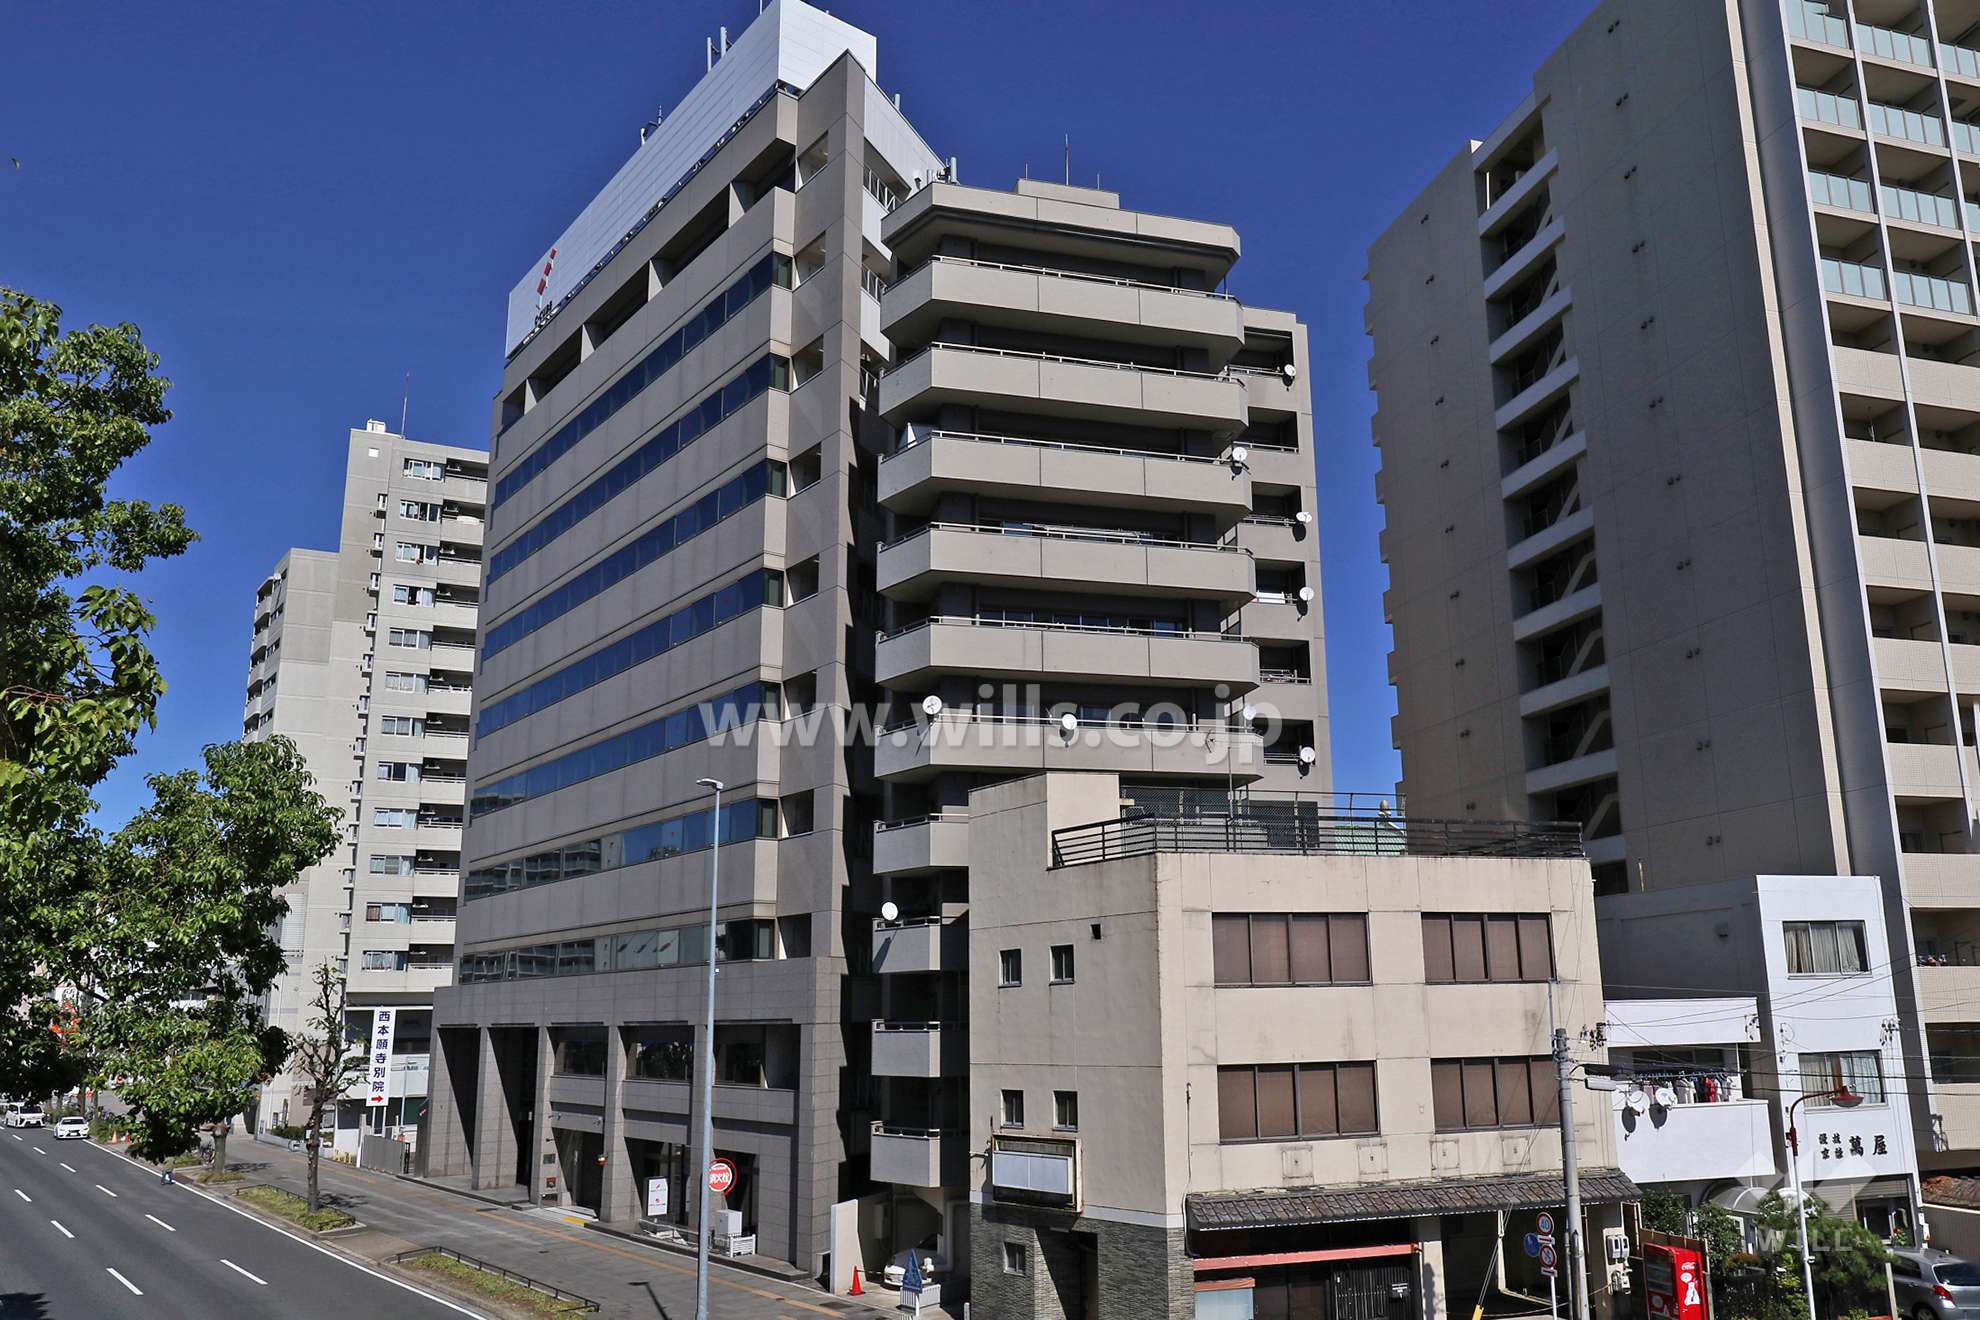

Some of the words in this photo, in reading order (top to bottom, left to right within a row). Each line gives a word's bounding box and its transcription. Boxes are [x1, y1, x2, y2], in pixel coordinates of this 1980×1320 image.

[372, 1010, 391, 1092] 西本願寺別院
